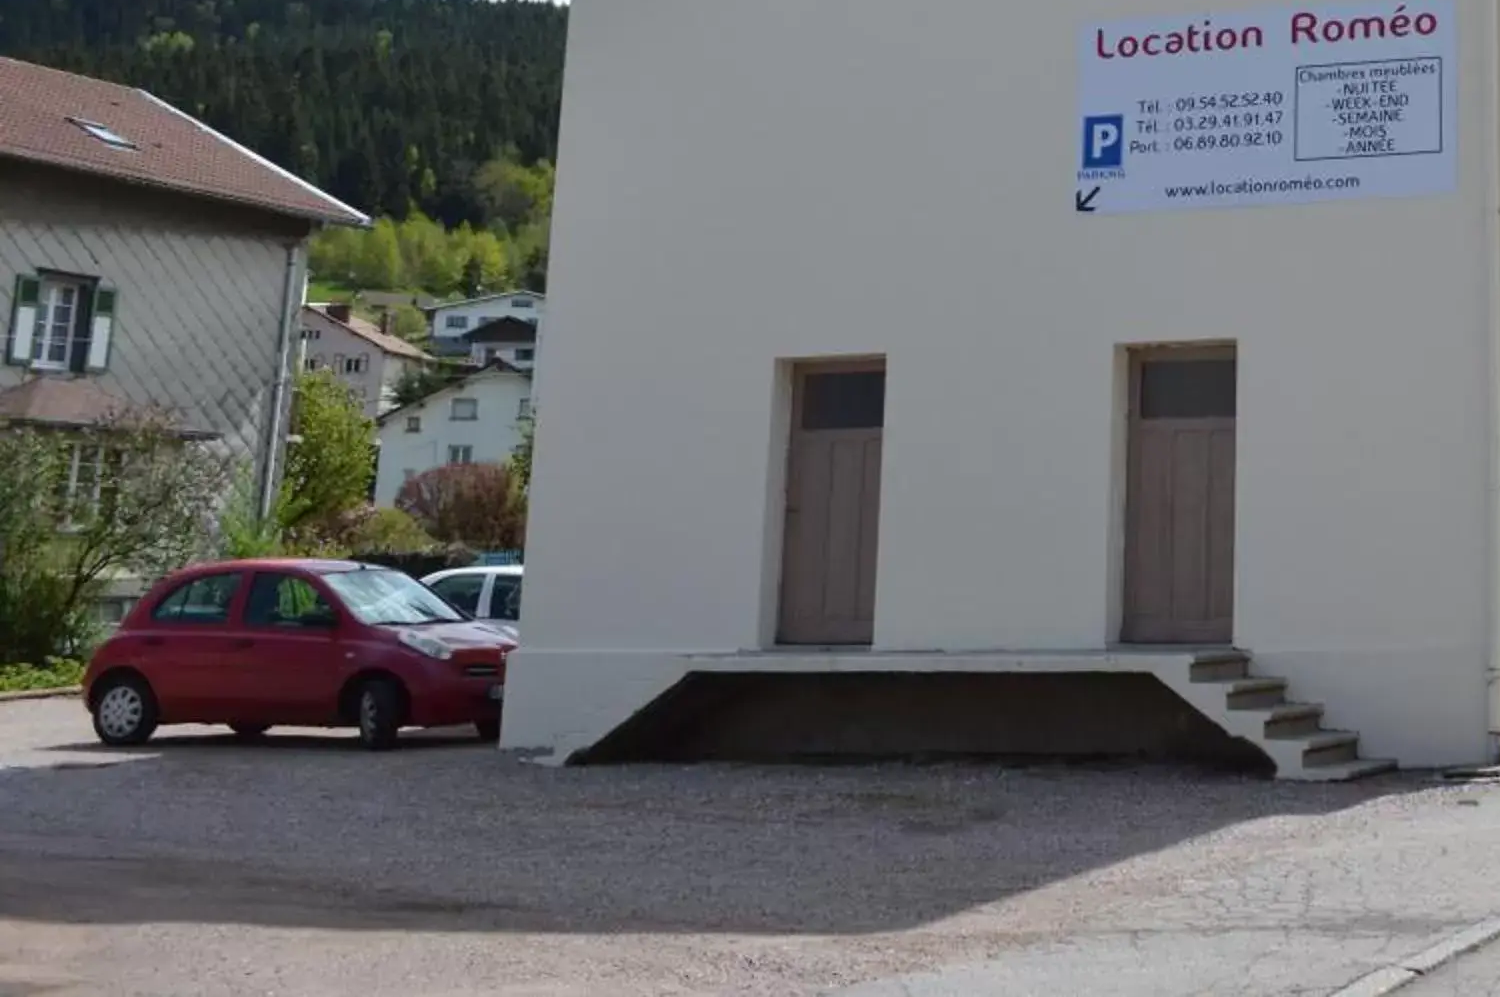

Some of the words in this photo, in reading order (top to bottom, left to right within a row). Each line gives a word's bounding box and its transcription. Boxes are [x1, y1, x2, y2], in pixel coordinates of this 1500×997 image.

[1096, 20, 1263, 59] Location
[1291, 5, 1438, 44] Roméo
[1300, 67, 1366, 84] Chambres
[1369, 61, 1436, 79] meublées
[1091, 122, 1119, 159] P
